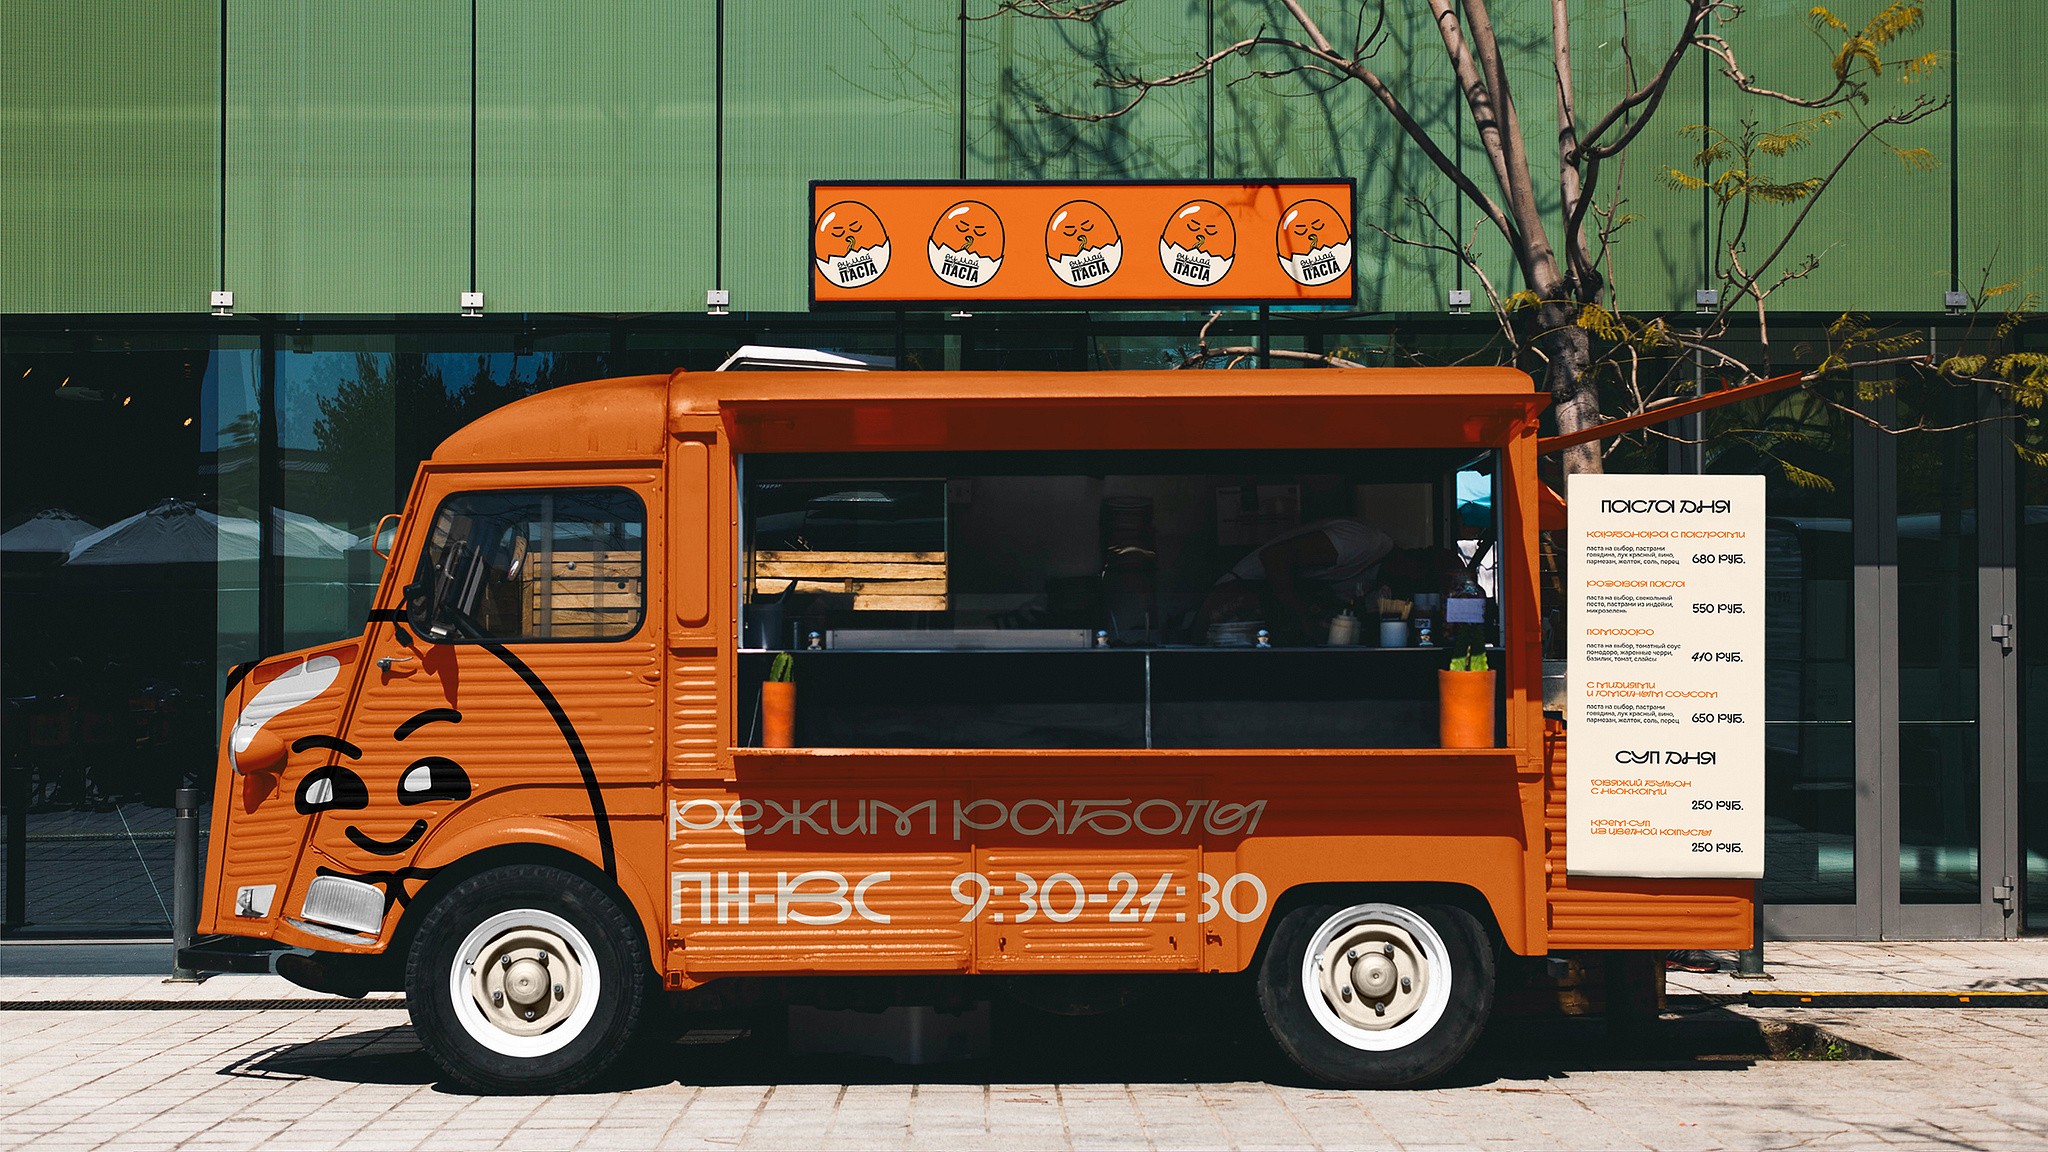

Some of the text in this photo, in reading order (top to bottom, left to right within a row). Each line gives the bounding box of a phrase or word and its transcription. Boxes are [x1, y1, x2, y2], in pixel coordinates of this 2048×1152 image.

[839, 260, 878, 283] ПАСТА
[941, 260, 979, 283] ПАСТА
[1071, 259, 1110, 282] ПАСТА
[1173, 259, 1210, 282] ПАСТА
[1302, 258, 1341, 281] ПАСТА
[1691, 553, 1716, 565] 680
[1692, 602, 1715, 614] 550
[1691, 712, 1715, 724] 650
[1691, 799, 1714, 811] 250
[1691, 841, 1714, 853] 250
[671, 871, 1268, 924] ПН-ВС 9:30-21:30
